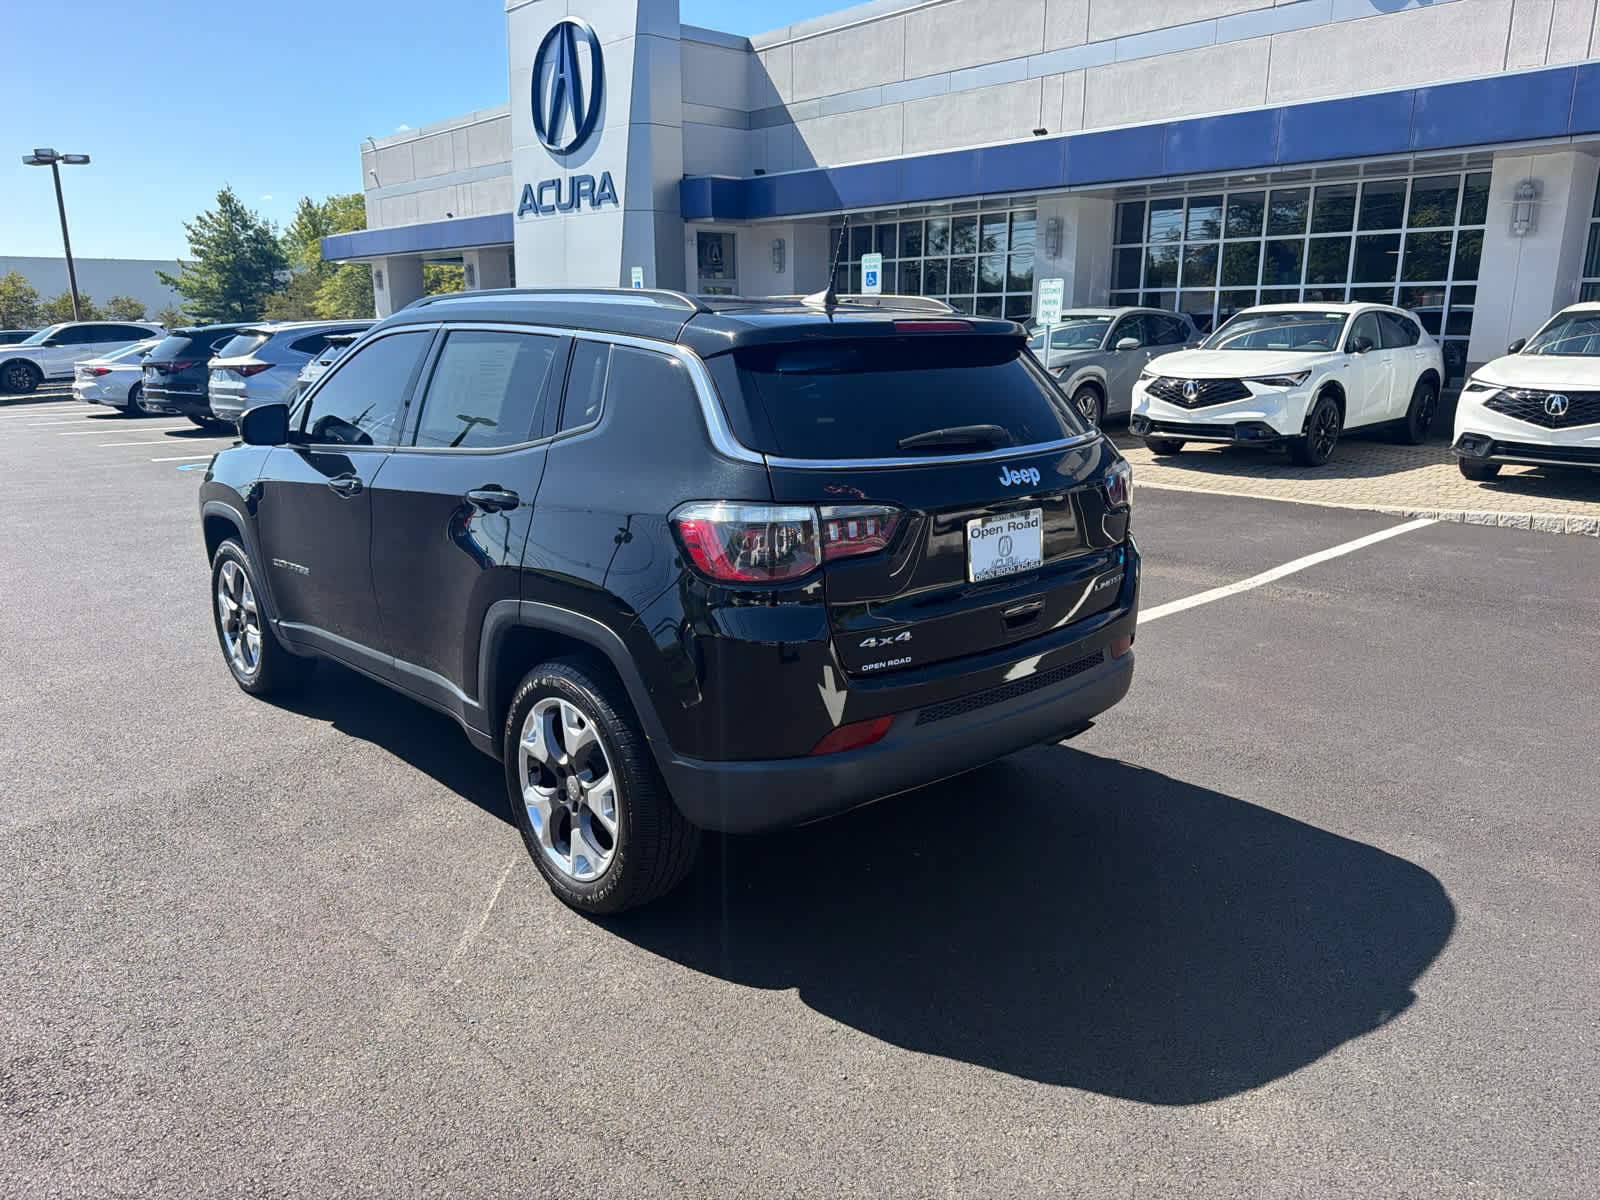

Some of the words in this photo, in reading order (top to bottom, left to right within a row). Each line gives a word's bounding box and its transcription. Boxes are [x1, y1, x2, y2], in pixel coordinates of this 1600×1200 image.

[517, 171, 618, 217] ACURA
[999, 466, 1041, 487] Jeep
[971, 526, 1003, 539] Open
[1008, 518, 1039, 532] Road
[861, 660, 886, 672] OPEN
[887, 656, 913, 667] ROAD
